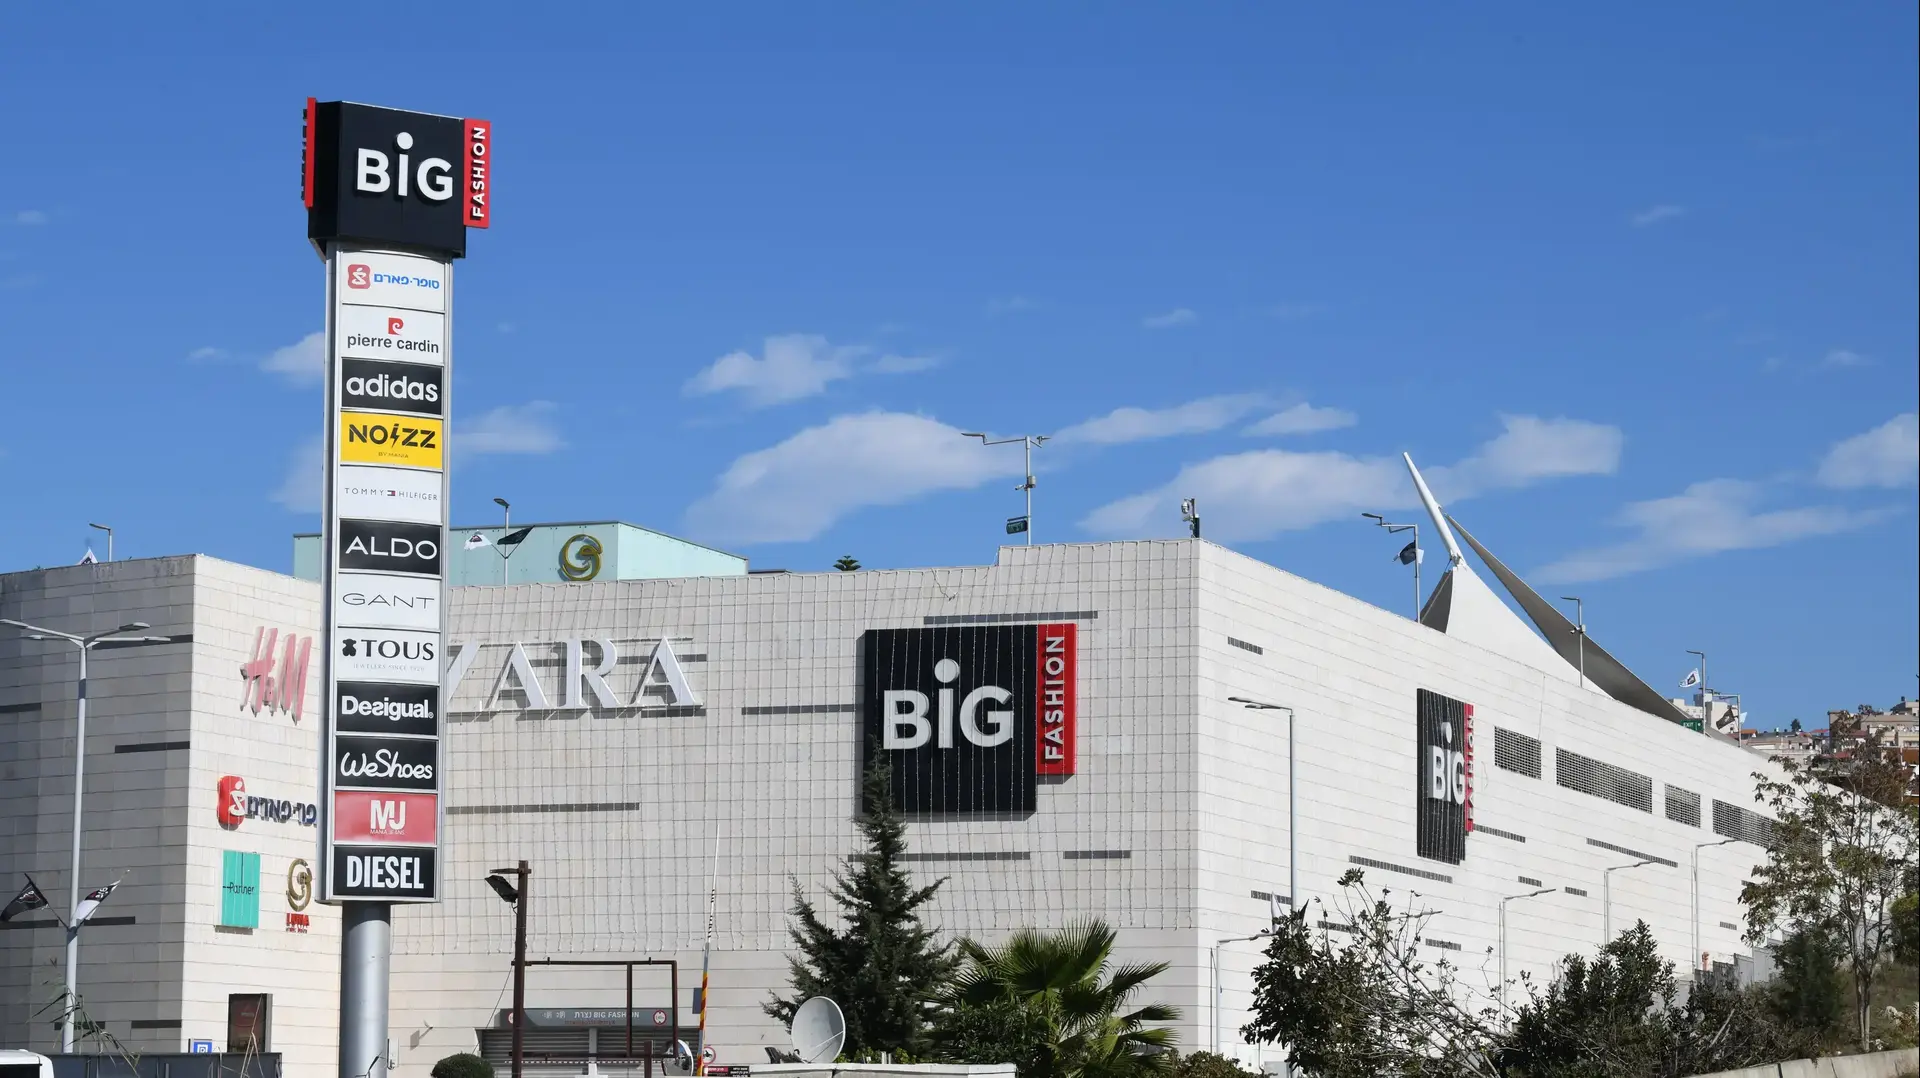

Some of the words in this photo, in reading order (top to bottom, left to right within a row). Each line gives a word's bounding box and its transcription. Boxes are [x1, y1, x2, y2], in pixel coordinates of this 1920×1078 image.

[472, 127, 486, 218] FASHION
[347, 334, 392, 349] pierre
[396, 337, 439, 353] cardin
[346, 374, 438, 402] adidas
[345, 488, 385, 496] TOMMY
[398, 491, 438, 501] HILFIGER
[345, 535, 437, 560] ALDO
[342, 592, 435, 609] GANT
[361, 639, 434, 661] TOUS
[1045, 636, 1065, 760] FASHION
[370, 800, 406, 830] MJ
[346, 855, 424, 889] DIESEL
[229, 881, 254, 895] Partner
